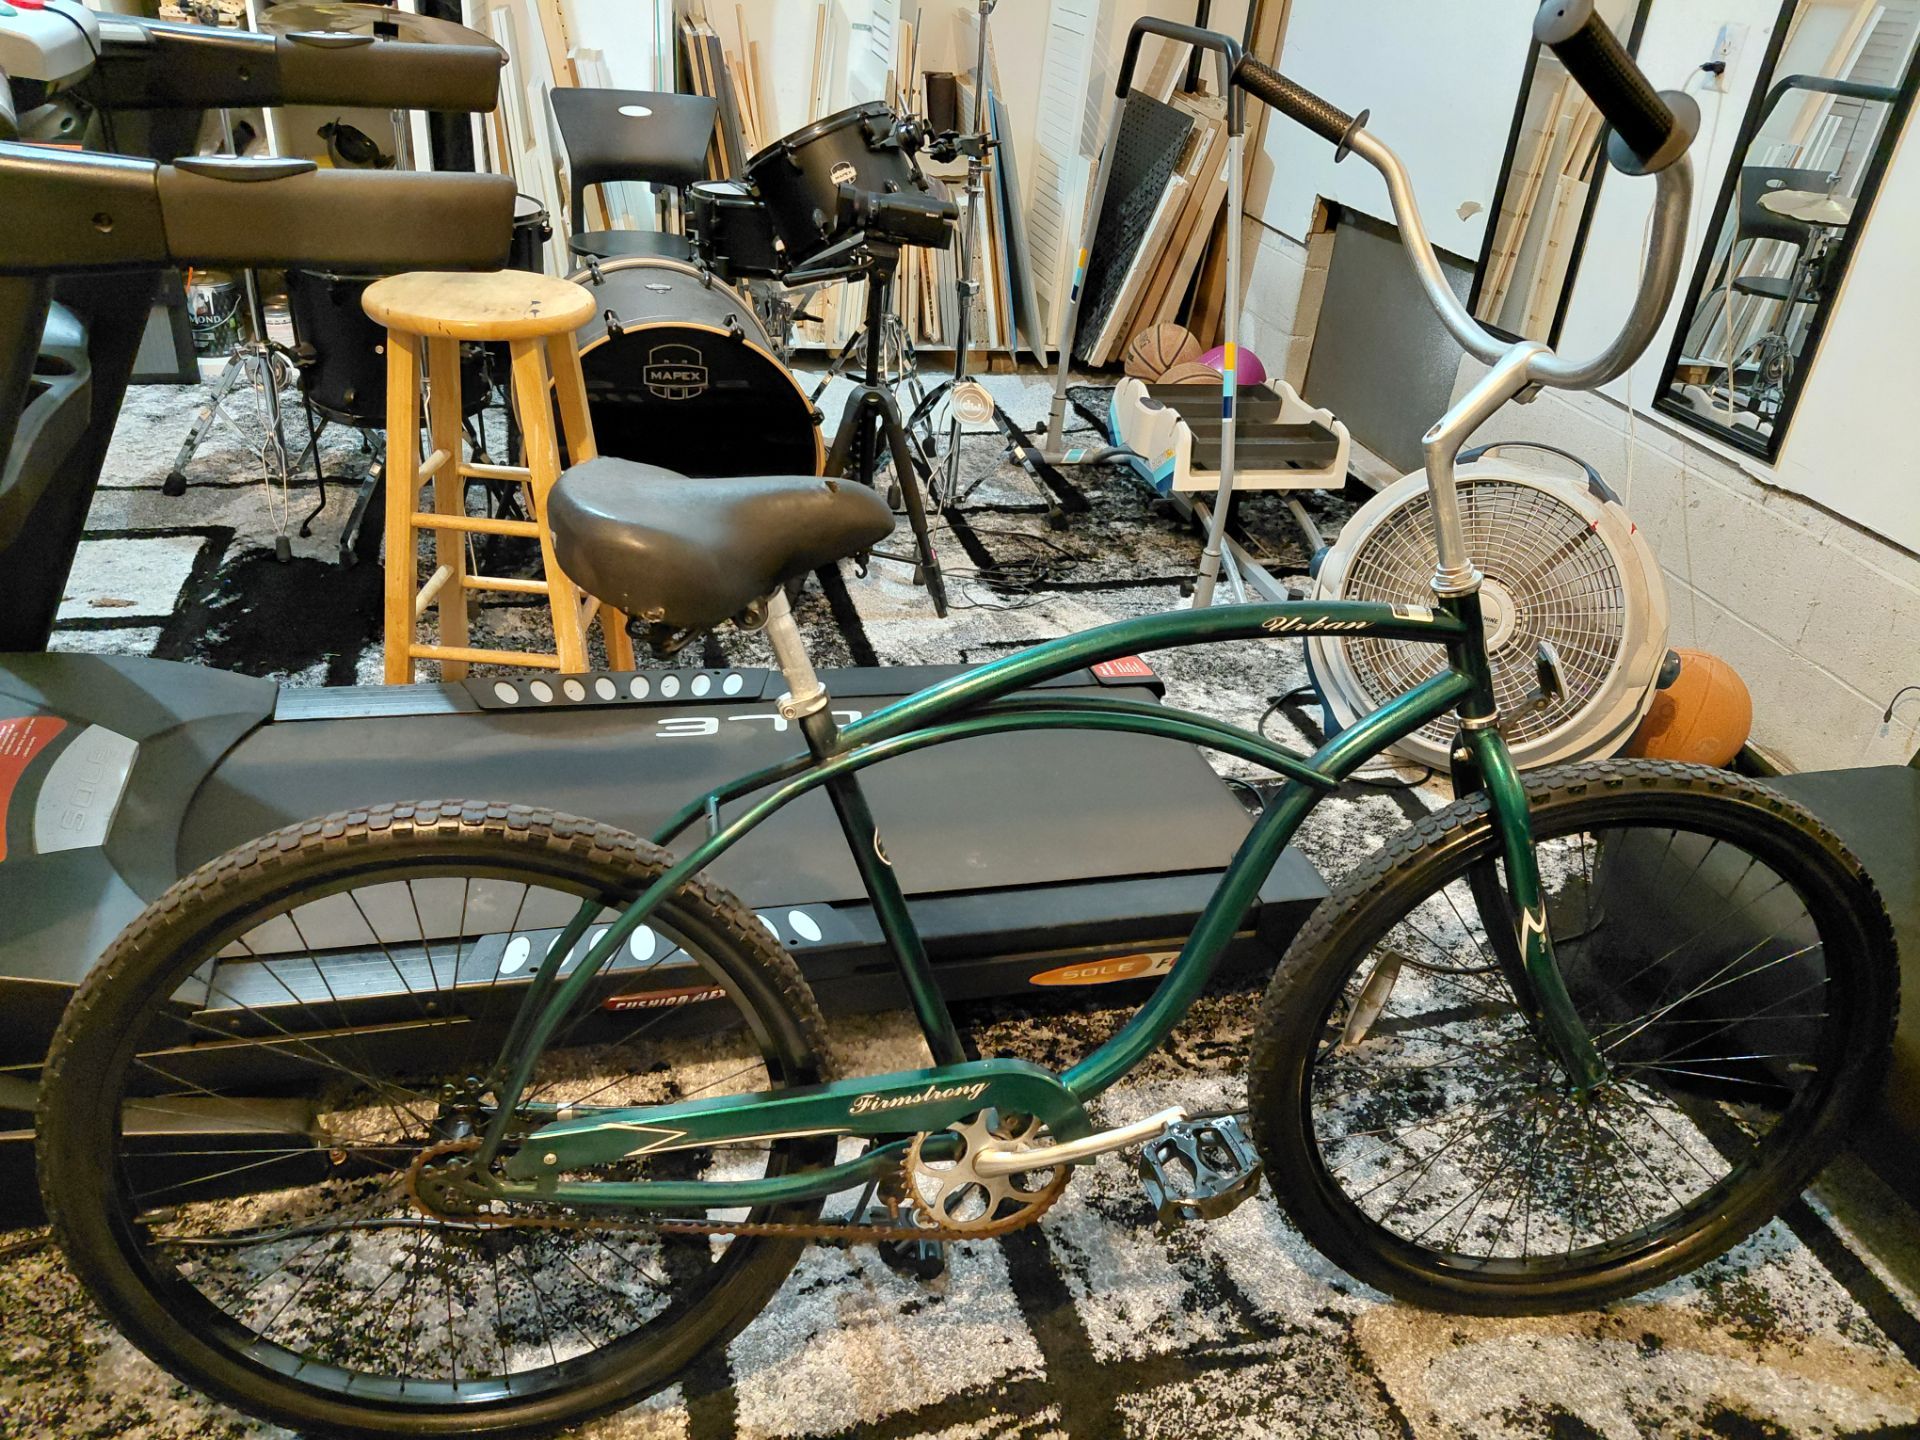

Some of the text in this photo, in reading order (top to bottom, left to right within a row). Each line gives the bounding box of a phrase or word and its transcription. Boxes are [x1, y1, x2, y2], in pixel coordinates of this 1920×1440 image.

[650, 371, 700, 381] MAPEX
[1261, 615, 1376, 633] Urban
[1062, 961, 1136, 980] SOLE
[850, 1081, 991, 1114] Firmstrong
